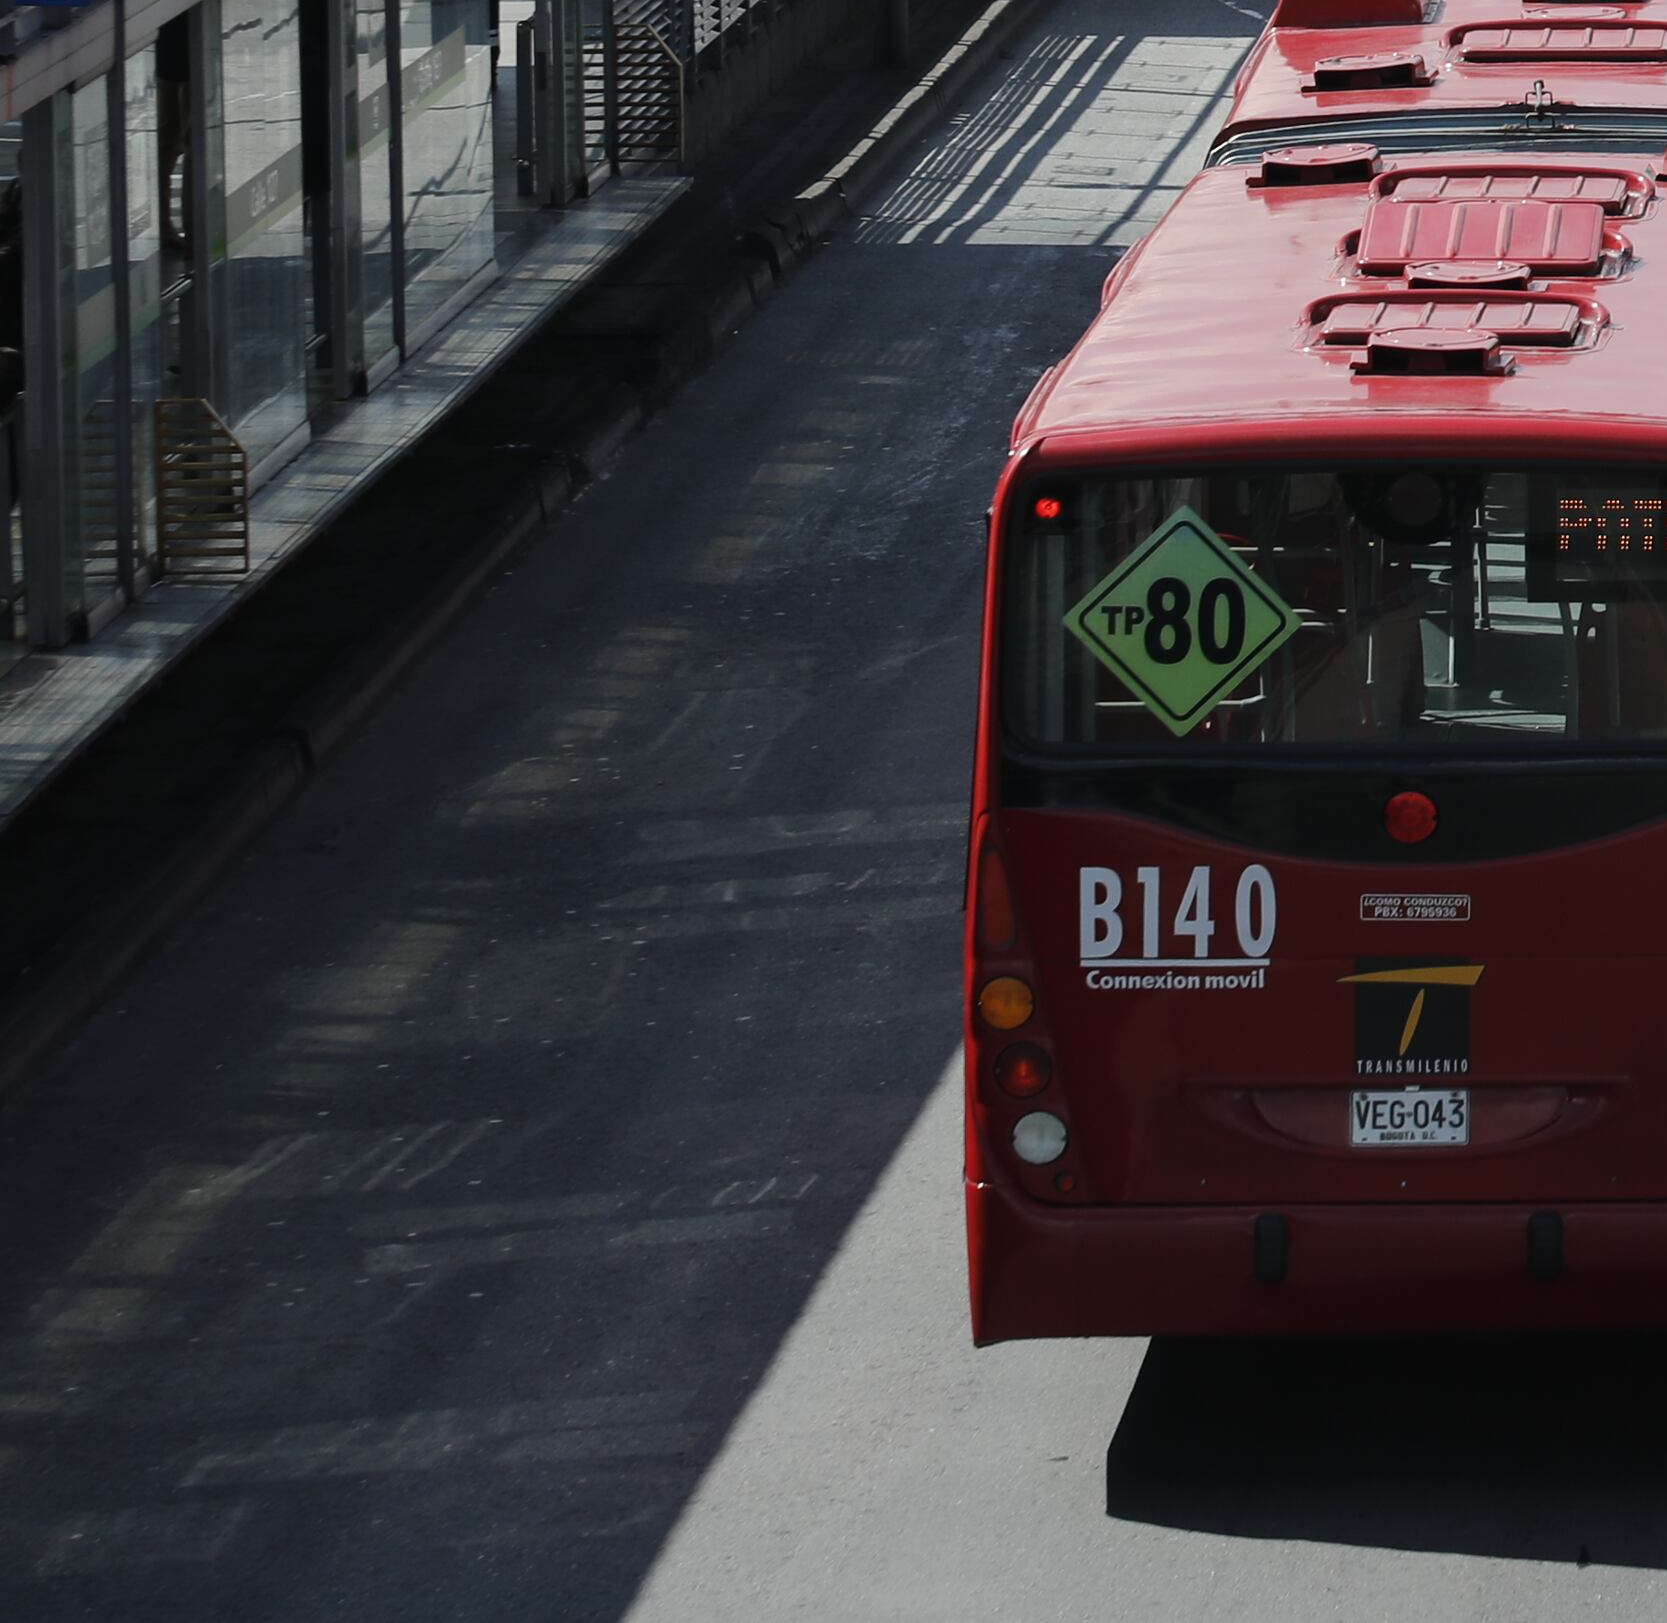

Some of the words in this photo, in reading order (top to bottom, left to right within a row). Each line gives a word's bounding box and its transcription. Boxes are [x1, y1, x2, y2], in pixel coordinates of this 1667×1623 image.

[1404, 896, 1470, 907] CONDUZCO?
[1079, 863, 1277, 959] B140
[1374, 906, 1405, 918] PBX:
[1086, 971, 1201, 990] Connexion
[1204, 969, 1265, 990] movil
[1356, 1059, 1470, 1074] TRANSMILENIO
